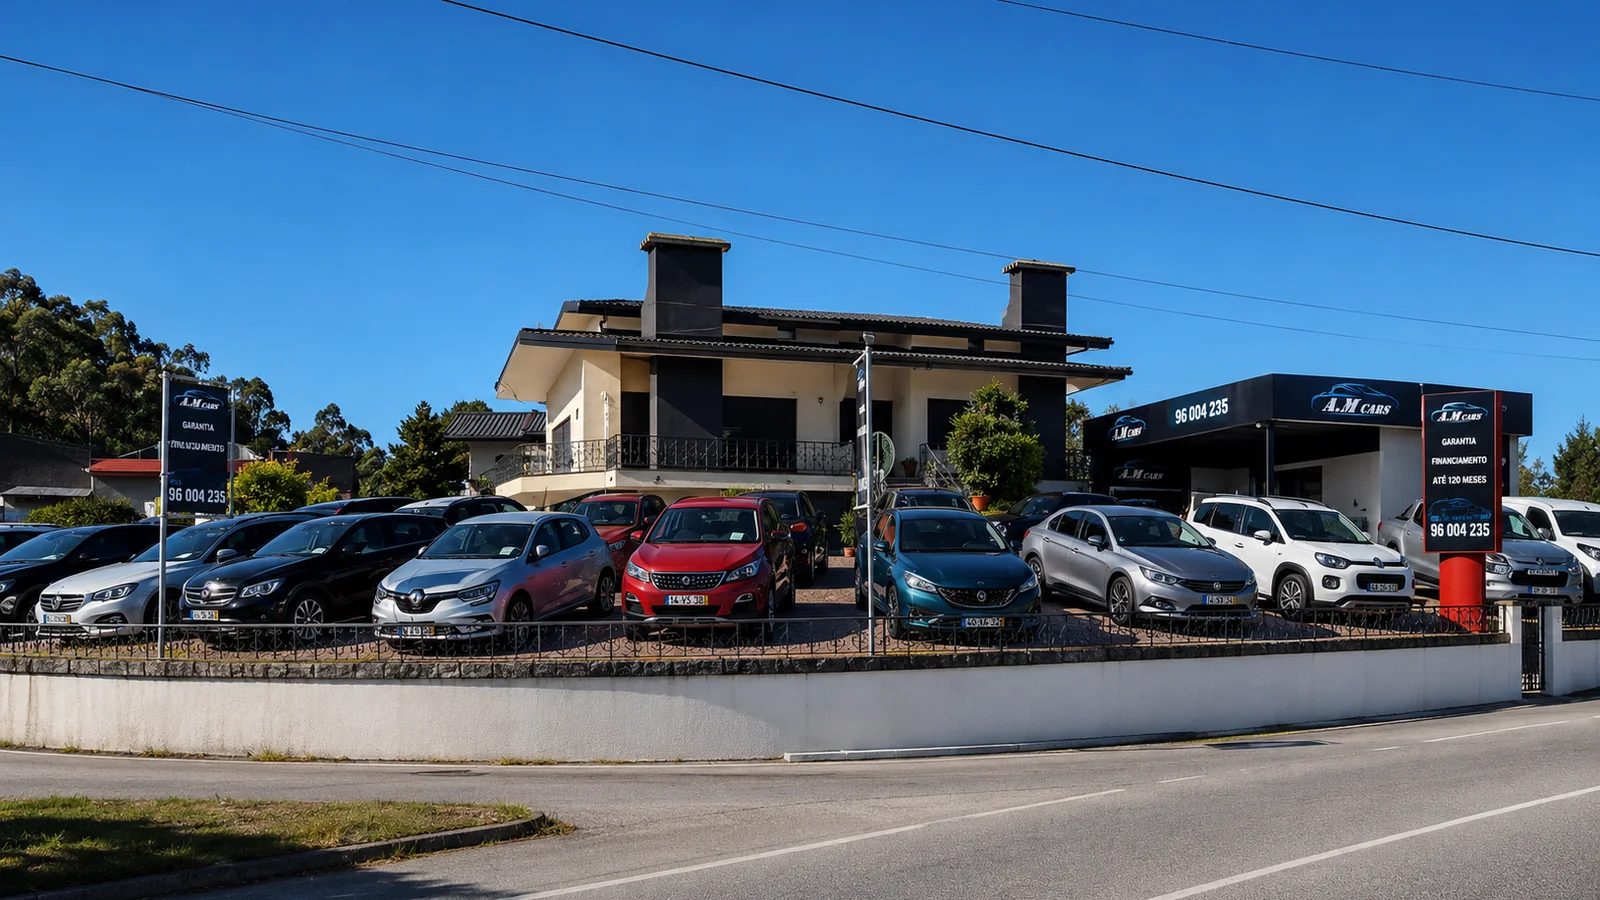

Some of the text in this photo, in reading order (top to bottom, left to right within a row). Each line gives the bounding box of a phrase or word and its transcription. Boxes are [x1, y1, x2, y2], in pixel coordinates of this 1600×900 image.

[1175, 397, 1229, 425] 96 004 235
[1360, 403, 1392, 415] CARS
[1461, 413, 1483, 421] CARS
[182, 420, 215, 432] GARANTIA
[1441, 437, 1477, 446] GARANTIA
[1431, 456, 1488, 465] FINANCIAMENTO
[1143, 472, 1164, 480] CARS
[1432, 475, 1487, 485] ATÉ 120 MESES
[168, 487, 226, 503] 96 004 235
[1430, 523, 1490, 537] 96 004 235
